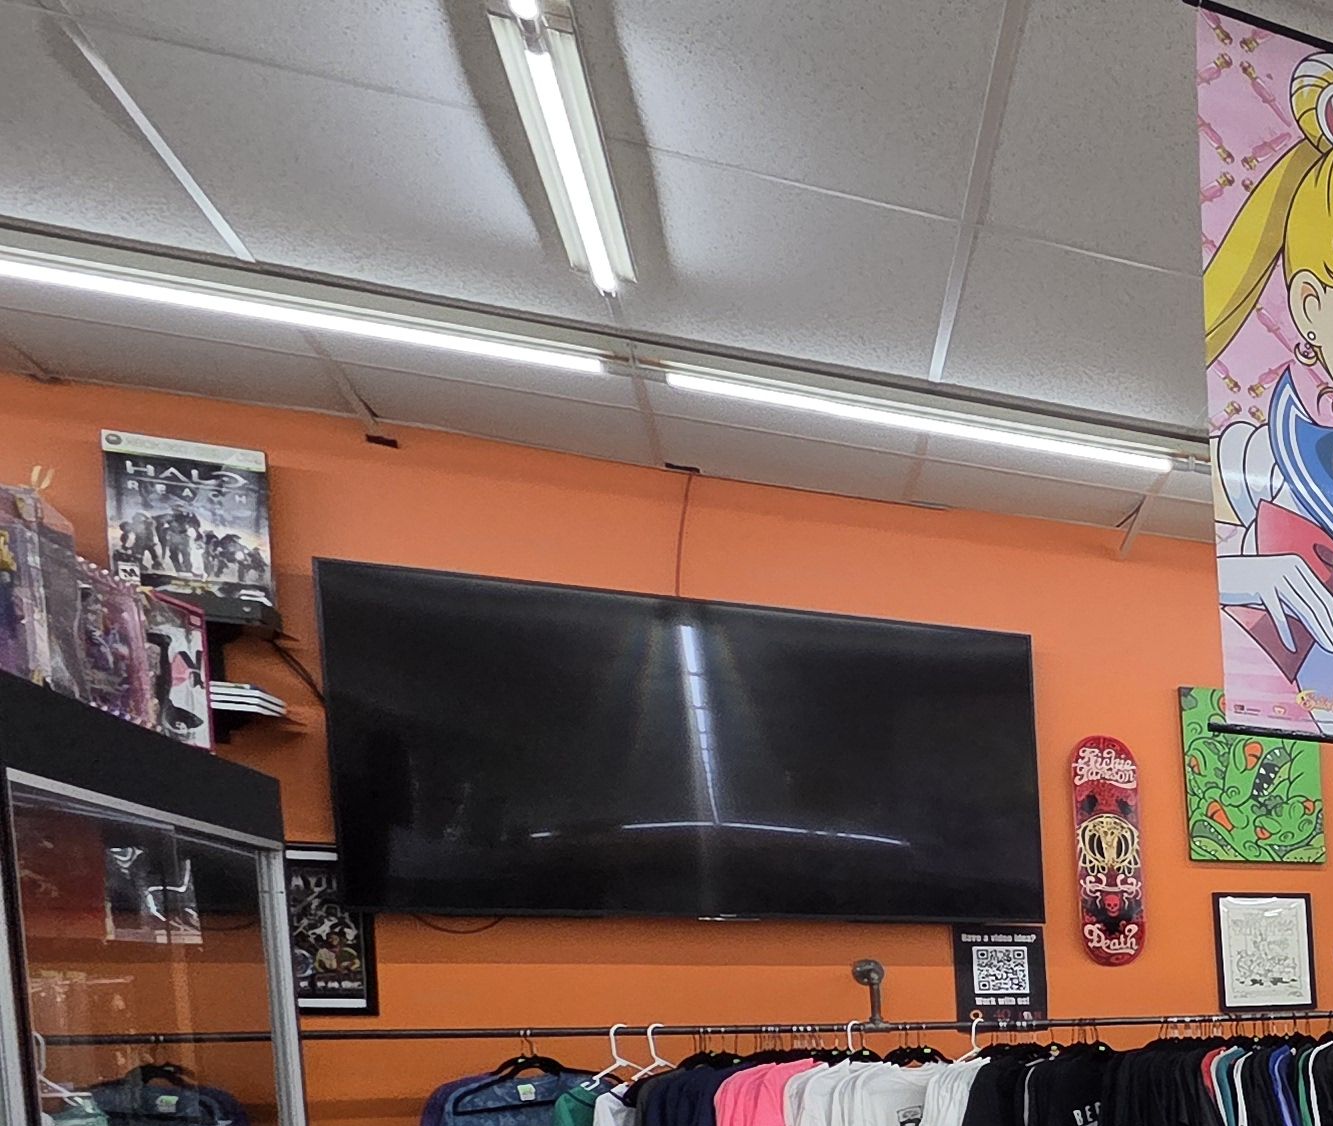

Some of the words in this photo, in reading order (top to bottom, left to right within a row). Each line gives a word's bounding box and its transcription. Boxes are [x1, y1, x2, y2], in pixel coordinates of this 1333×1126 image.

[125, 459, 249, 488] HALO
[127, 480, 247, 504] REACH
[1084, 924, 1138, 954] Death
